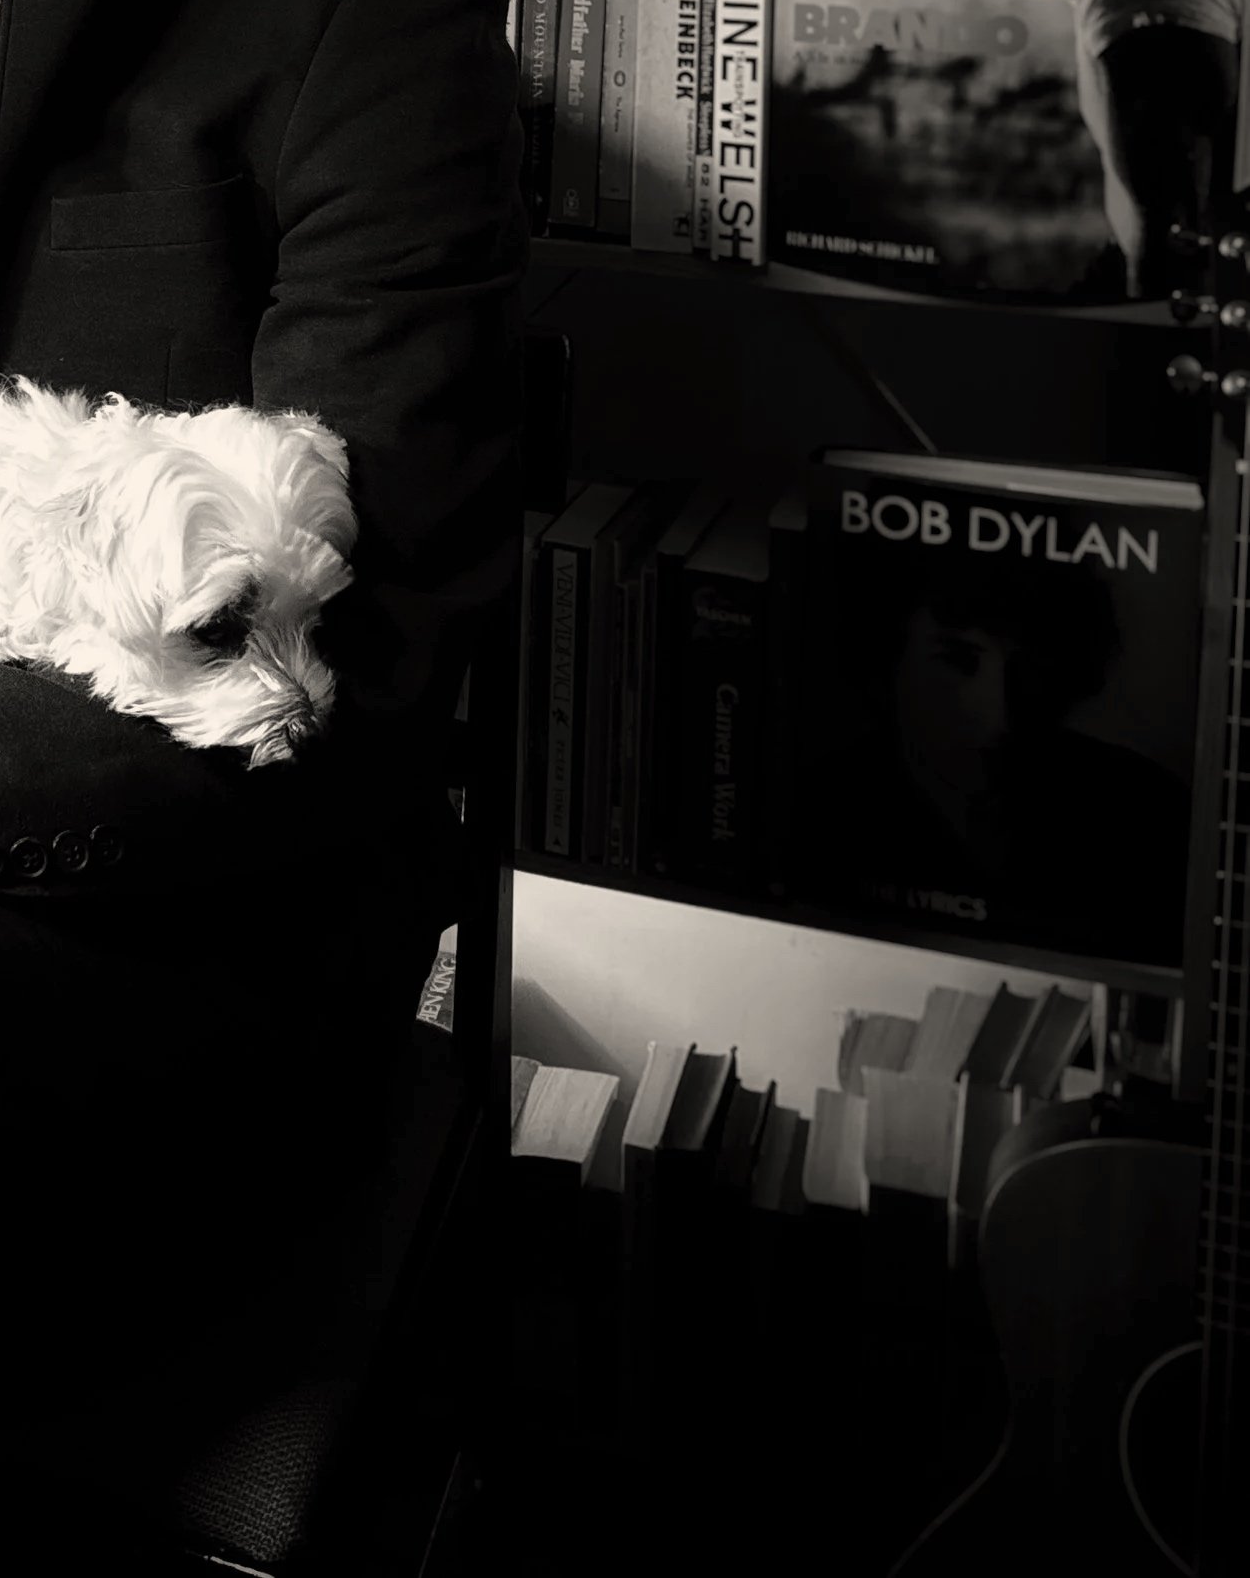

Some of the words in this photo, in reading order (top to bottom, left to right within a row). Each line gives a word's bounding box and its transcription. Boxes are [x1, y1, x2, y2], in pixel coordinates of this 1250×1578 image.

[533, 12, 546, 100] MOUNTAIN
[793, 3, 1029, 57] BRANDO
[717, 98, 758, 262] WELSH
[841, 490, 952, 546] BOB
[968, 507, 1159, 573] DYLAN
[713, 683, 739, 775] Camera
[711, 783, 736, 841] Work
